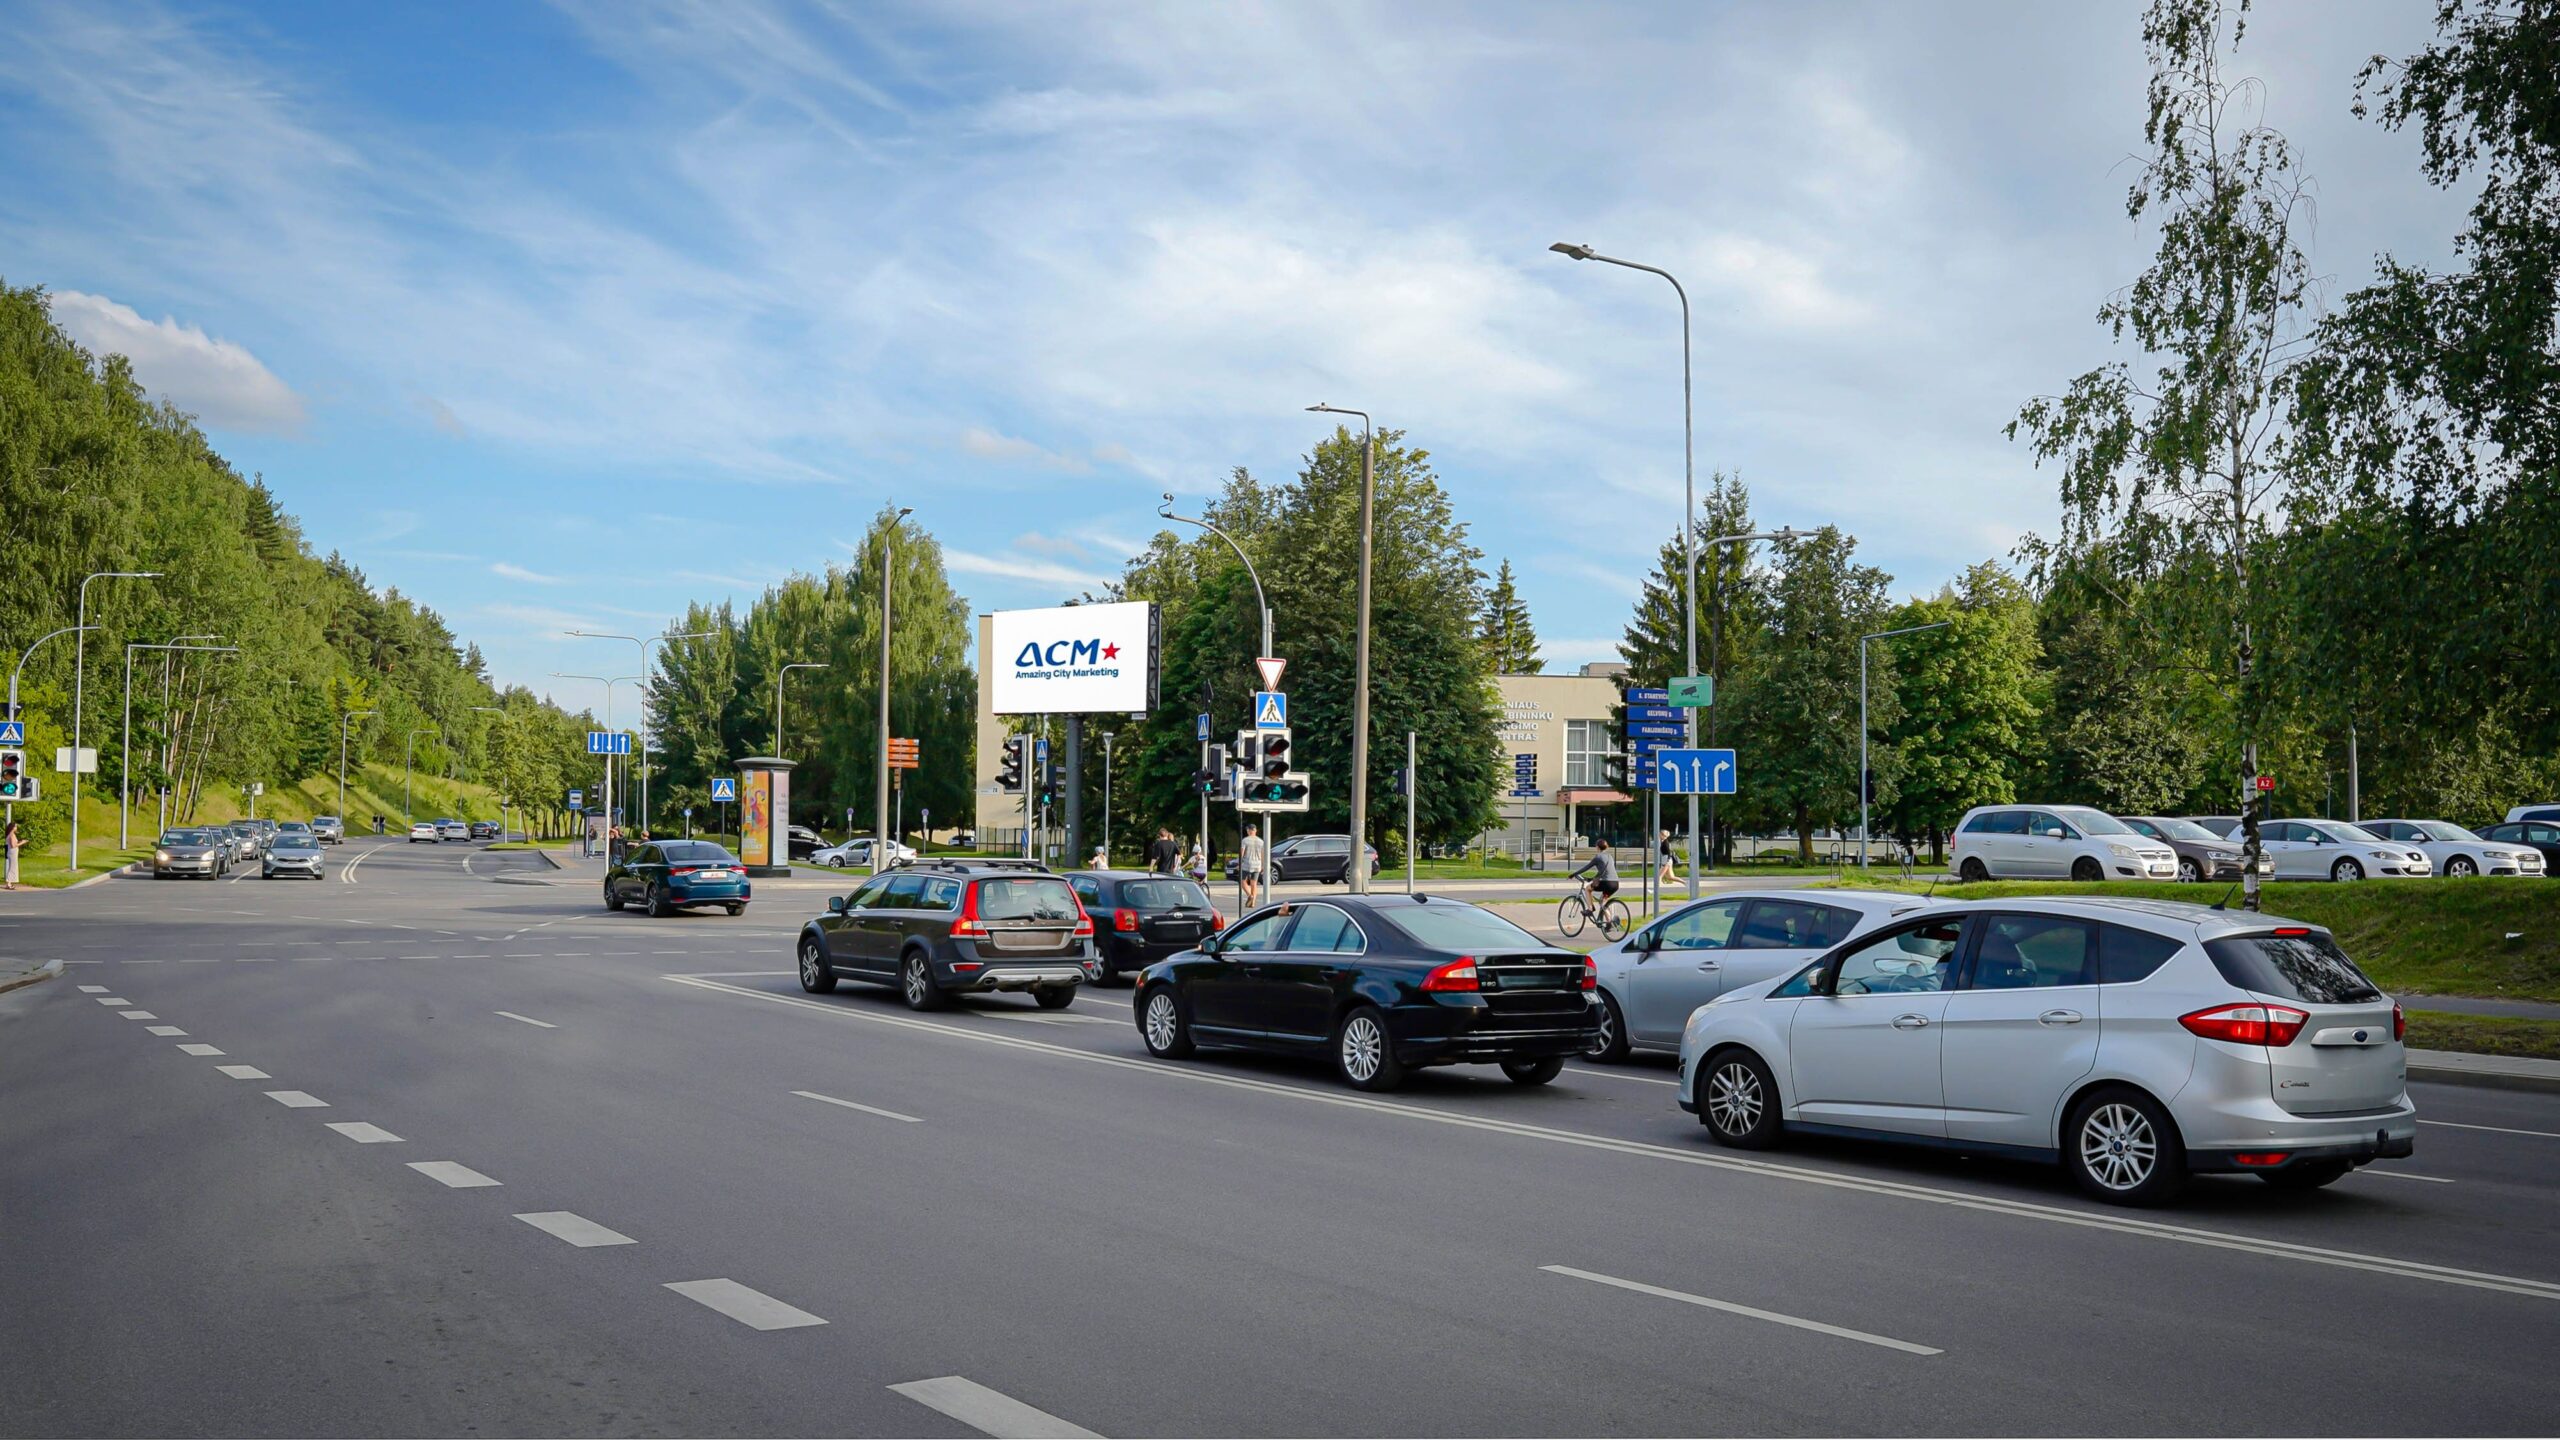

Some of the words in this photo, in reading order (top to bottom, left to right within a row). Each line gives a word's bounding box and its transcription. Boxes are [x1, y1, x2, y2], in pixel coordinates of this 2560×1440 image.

[1015, 638, 1100, 667] ACM
[1015, 669, 1052, 680] Amazing
[1053, 668, 1071, 679] City
[1072, 667, 1119, 678] Marketing
[1495, 731, 1538, 741] ENTRAS
